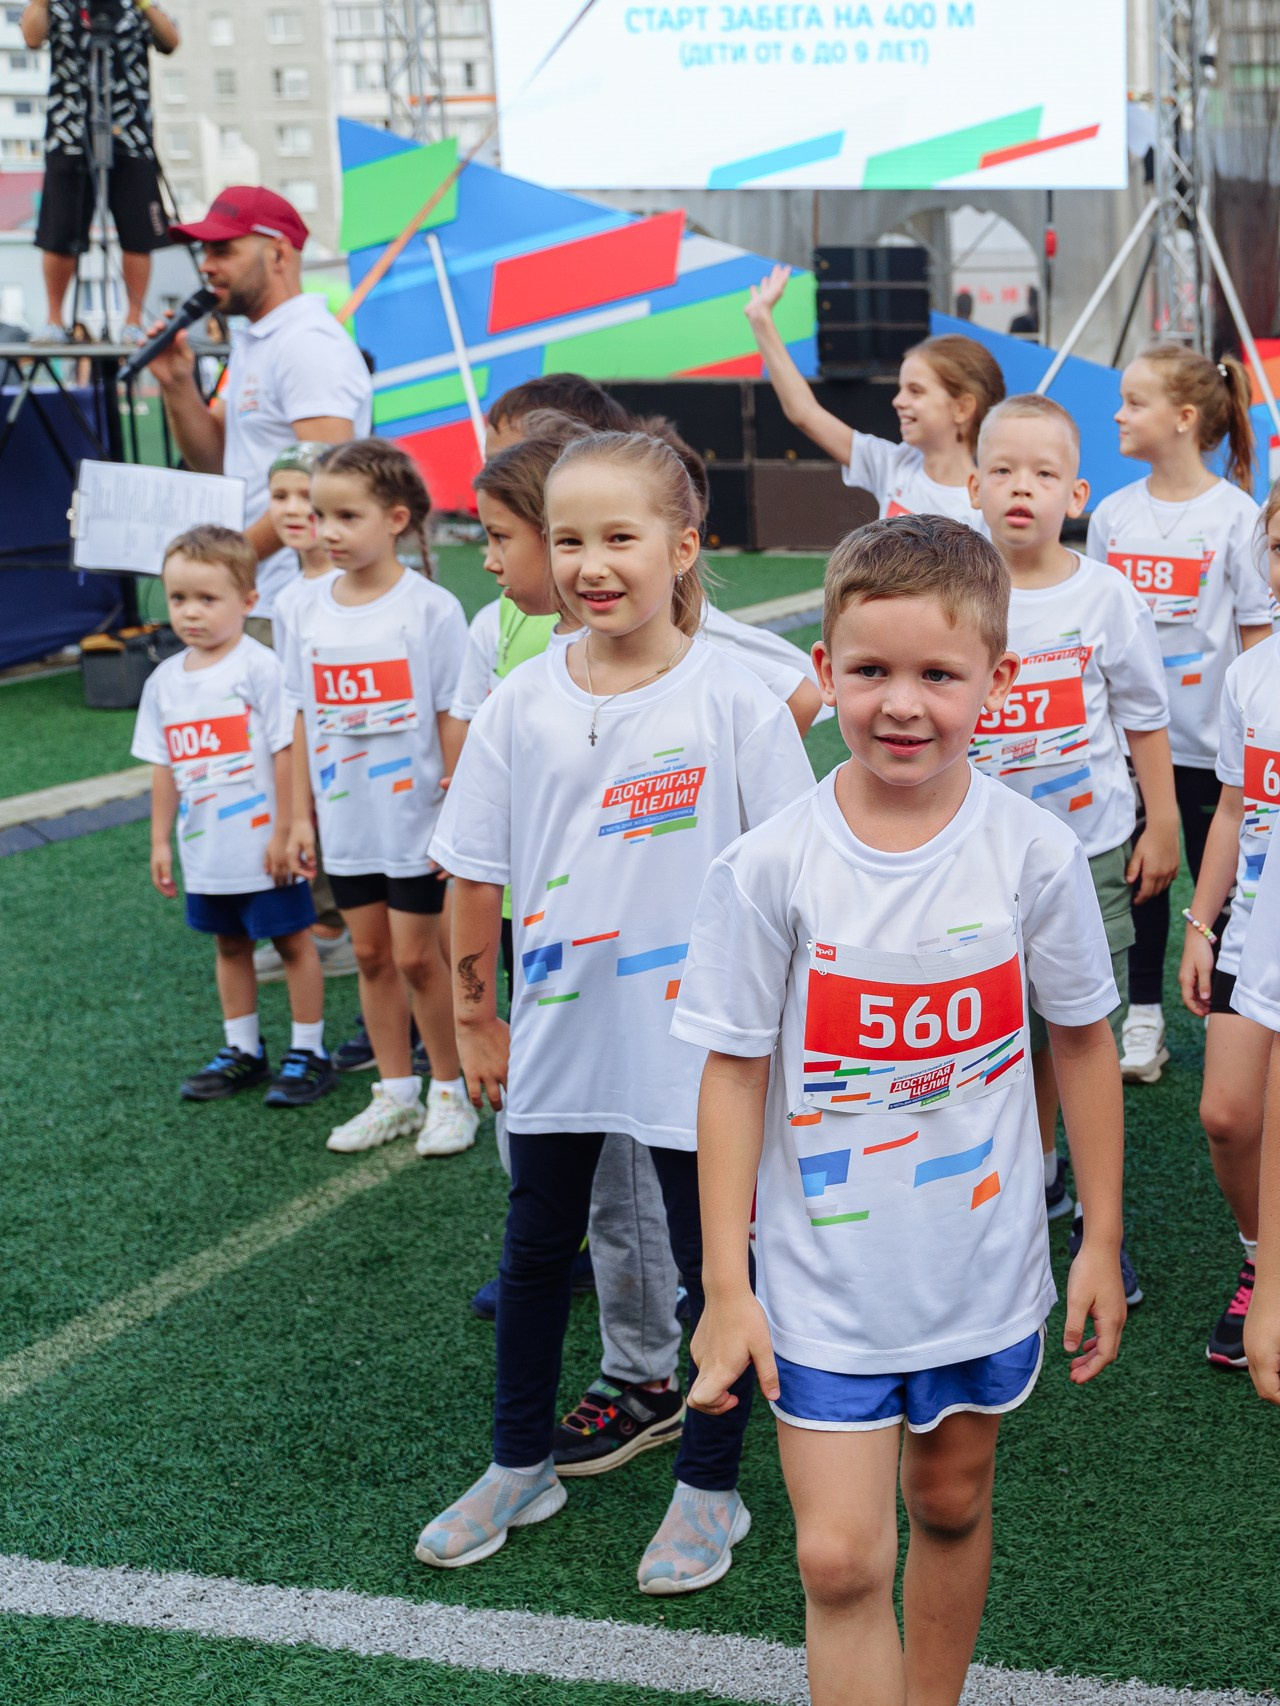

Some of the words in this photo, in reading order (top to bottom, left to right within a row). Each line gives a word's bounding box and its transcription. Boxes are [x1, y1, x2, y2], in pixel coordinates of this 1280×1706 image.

[624, 6, 708, 33] СТАРТ
[718, 4, 823, 31] ЗАБЕГА
[834, 4, 873, 30] НА
[883, 2, 937, 29] 400
[947, 3, 975, 28] М
[679, 41, 747, 68] (ДЕТИ
[754, 41, 783, 64] ОТ
[791, 43, 806, 64] 6
[812, 41, 848, 66] ДО
[854, 41, 870, 63] 9
[876, 38, 929, 64] ЛЕТ)
[1122, 558, 1174, 590] 158
[323, 667, 382, 701] 161
[169, 724, 221, 758] 004
[609, 770, 700, 805] ДОСТИГАЯ
[634, 787, 695, 815] ЦЕЛИ!
[858, 986, 984, 1050] 560
[893, 1065, 951, 1092] ДОСТИГАЯ
[912, 1075, 948, 1096] ЦЕЛИ!
